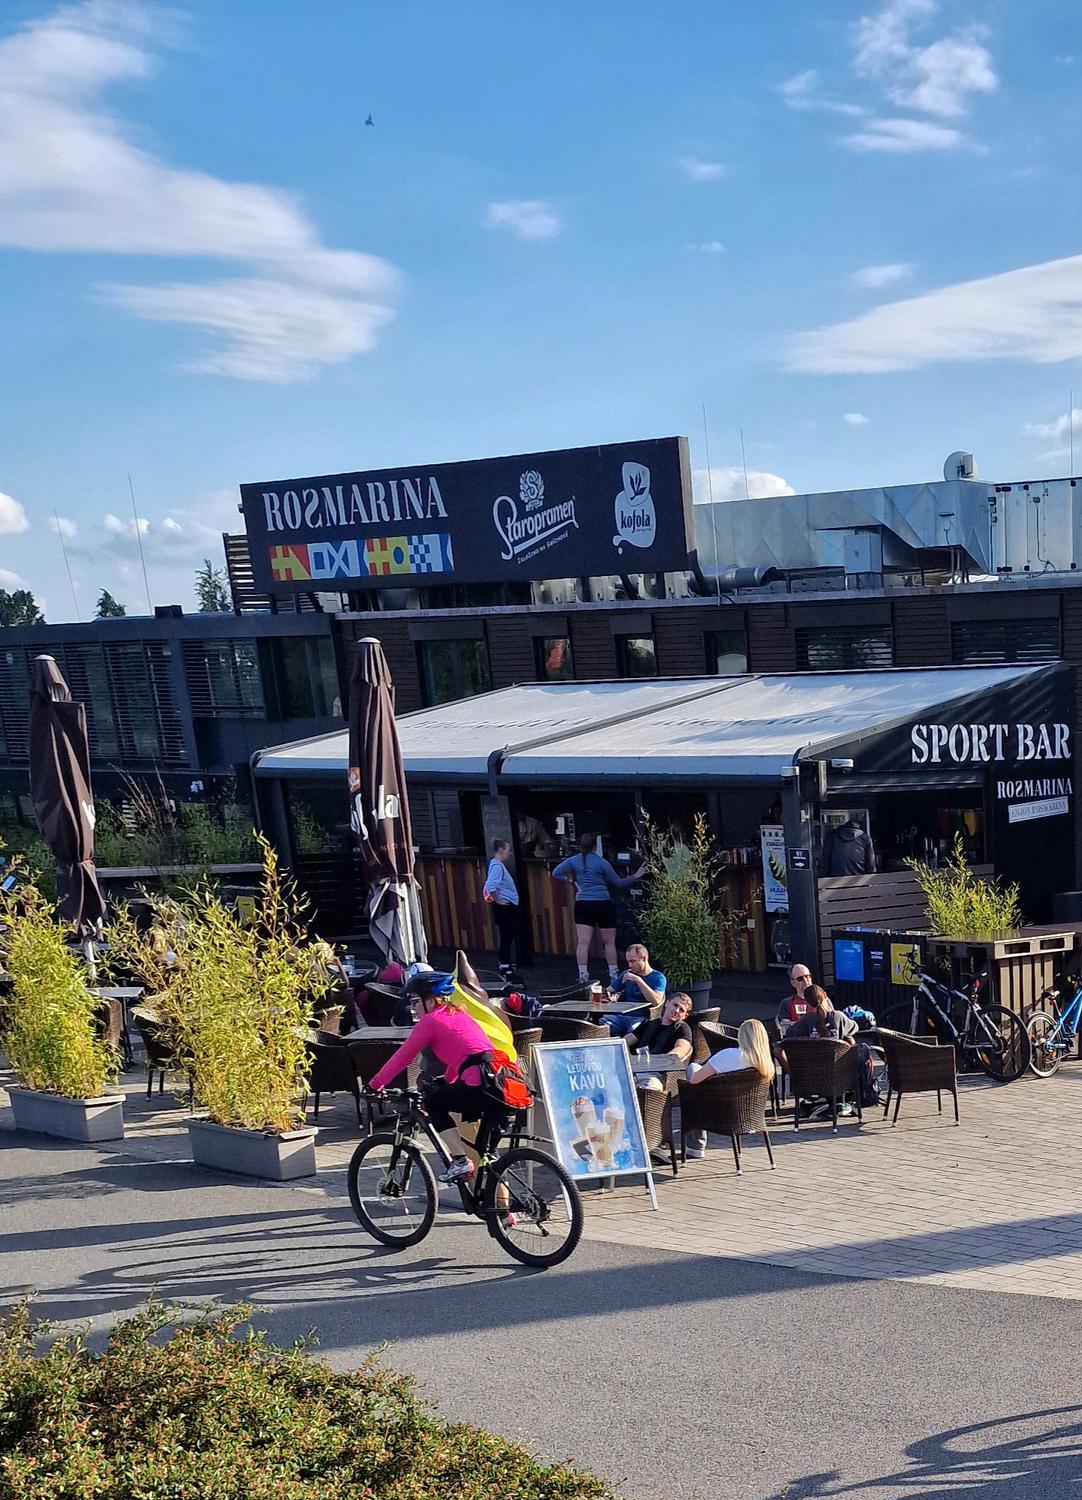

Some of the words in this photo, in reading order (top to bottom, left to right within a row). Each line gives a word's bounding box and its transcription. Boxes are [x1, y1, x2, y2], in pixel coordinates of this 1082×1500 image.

[262, 476, 448, 531] ROSMARINA
[493, 494, 579, 560] Staropramen
[620, 508, 651, 534] kofola
[911, 723, 1008, 763] SPORT
[1016, 723, 1072, 760] BAR
[997, 778, 1073, 799] ROSMARINA
[569, 1072, 605, 1092] KÁVU
